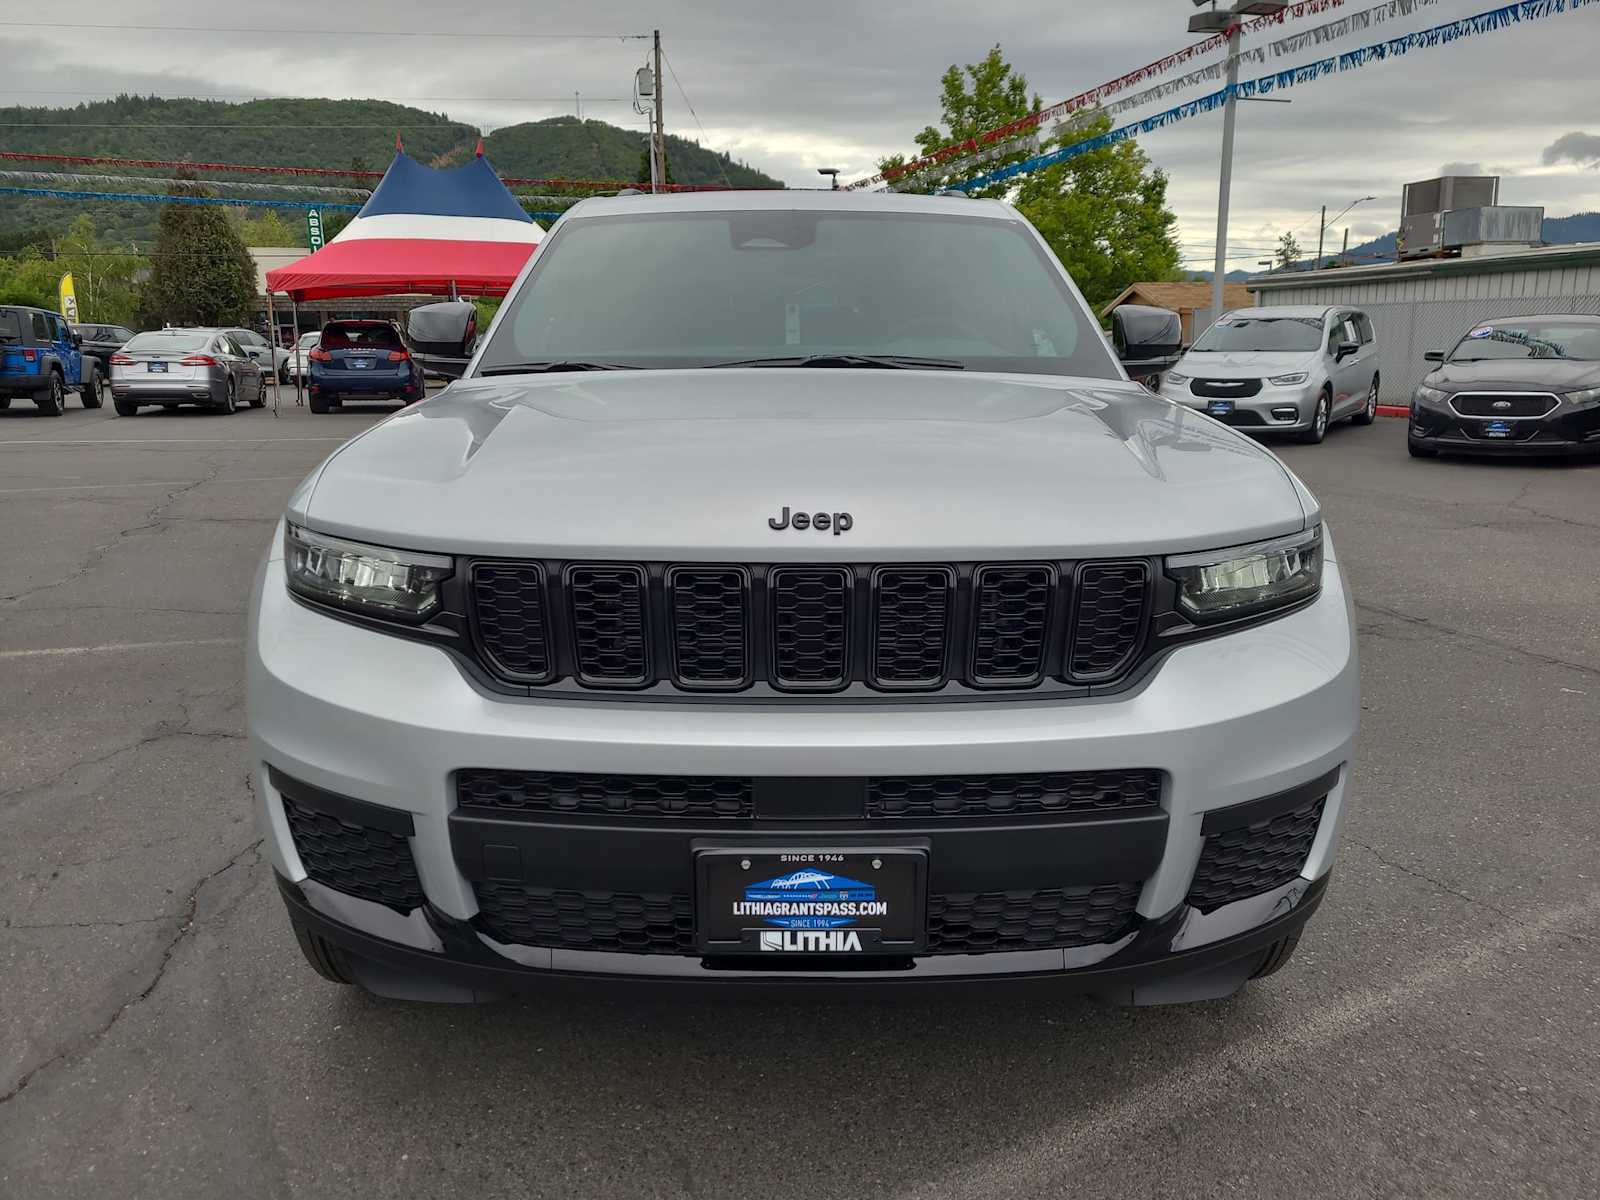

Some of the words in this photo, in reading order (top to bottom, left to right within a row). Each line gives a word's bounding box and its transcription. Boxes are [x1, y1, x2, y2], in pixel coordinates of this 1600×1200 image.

[768, 507, 853, 536] Jeep
[780, 854, 815, 862] SINCE
[818, 854, 844, 862] 1946
[732, 901, 888, 916] LITHIAGRANTSPASS.COM
[790, 919, 810, 928] SINCE
[783, 931, 863, 951] LITHIA
